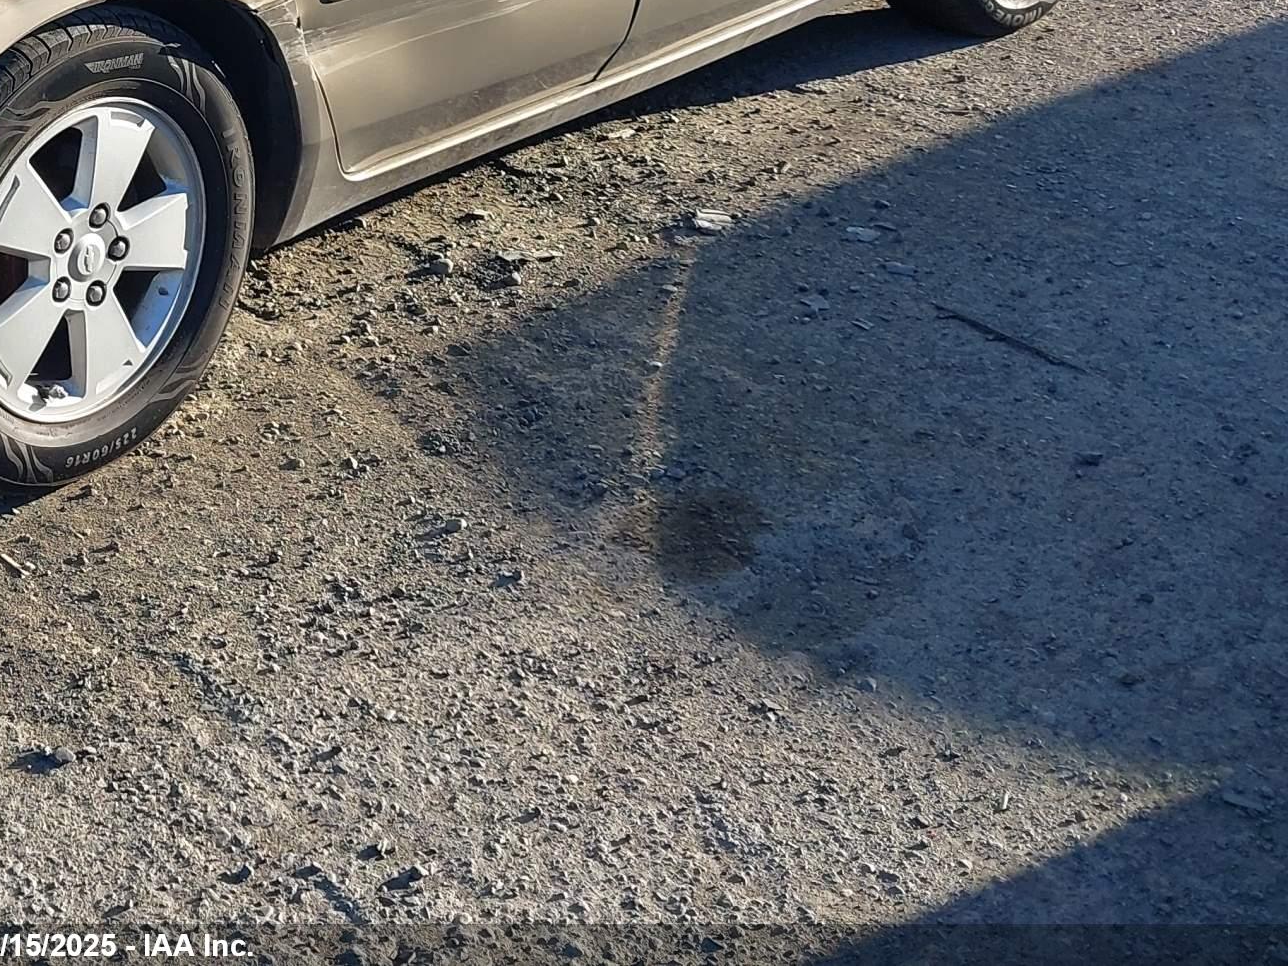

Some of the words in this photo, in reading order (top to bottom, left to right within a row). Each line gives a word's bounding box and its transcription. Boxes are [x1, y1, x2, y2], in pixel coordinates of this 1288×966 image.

[84, 52, 144, 73] IRONMAN
[220, 128, 249, 310] IRONMAN
[65, 427, 137, 468] 225/60R16
